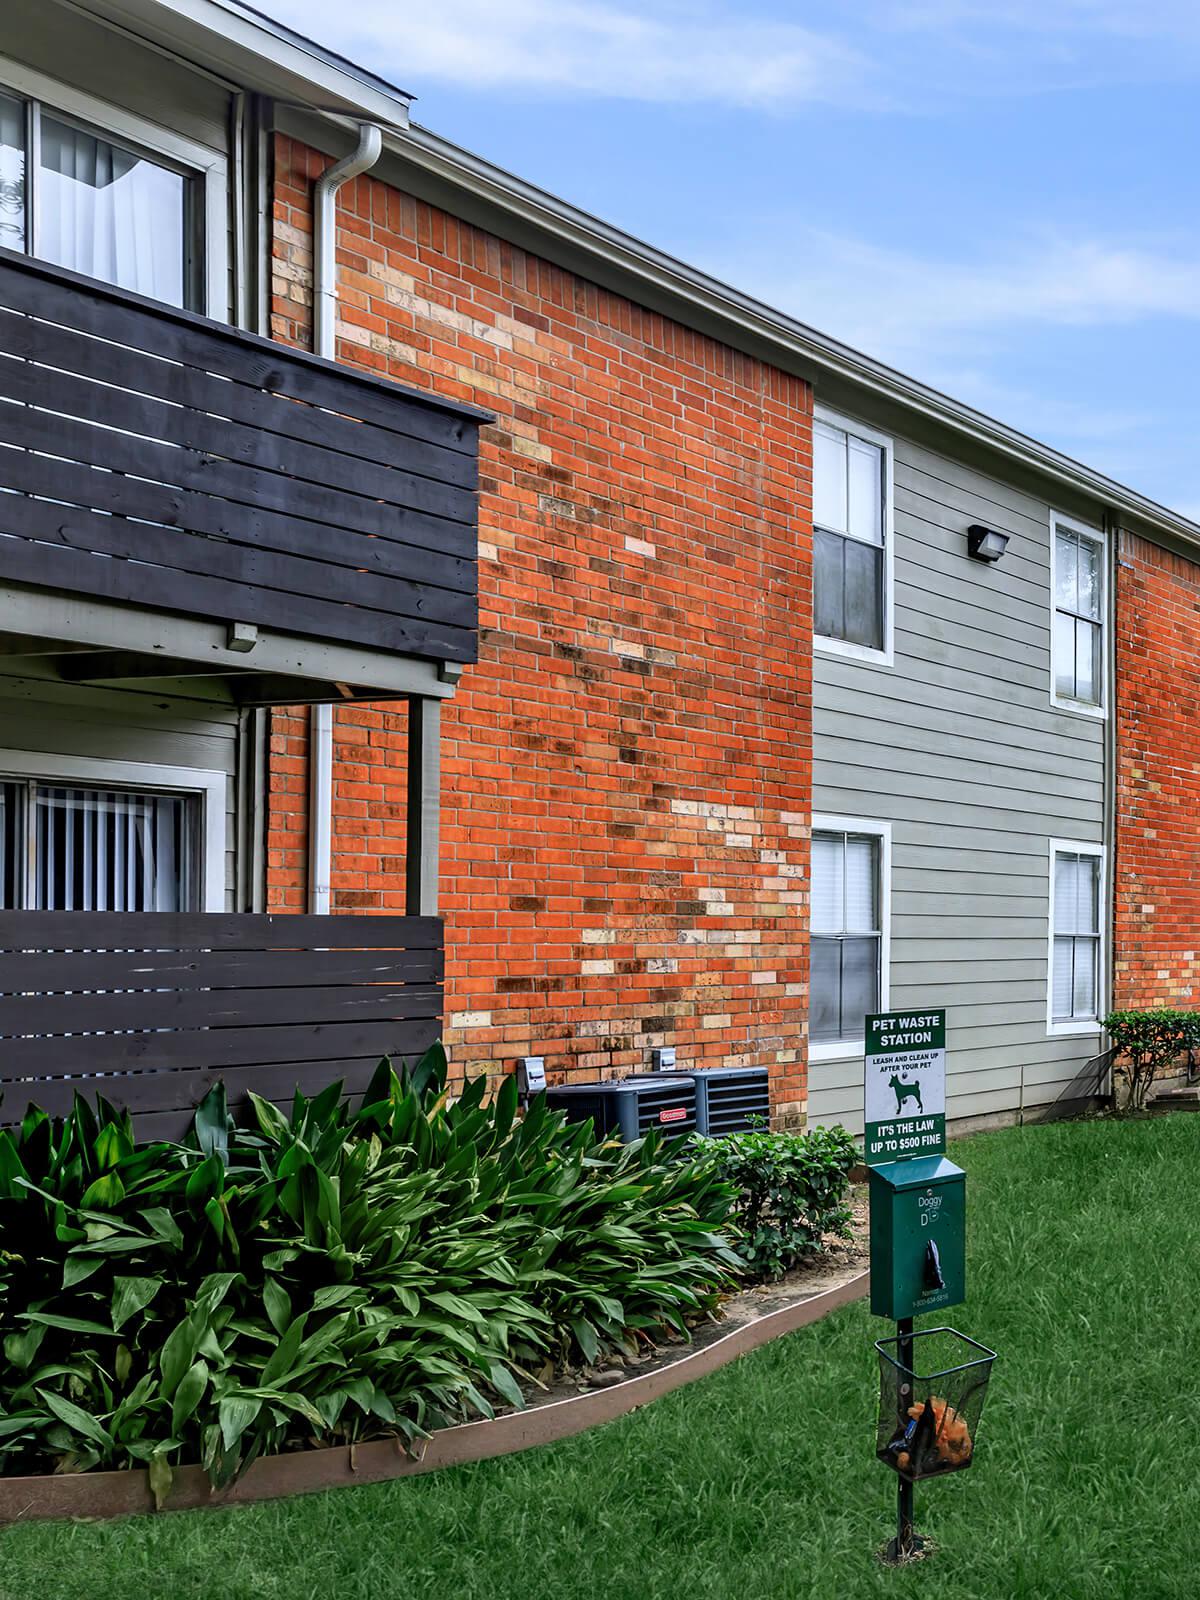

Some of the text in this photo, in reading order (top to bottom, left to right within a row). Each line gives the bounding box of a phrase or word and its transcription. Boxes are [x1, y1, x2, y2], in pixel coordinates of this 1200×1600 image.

[872, 1015, 940, 1031] PET WASTE
[880, 1031, 932, 1046] STATION
[872, 1056, 894, 1065] LEASH
[894, 1055, 907, 1063] AND
[879, 1061, 932, 1073] AFTER YOUR PET
[877, 1120, 935, 1137] IT'S THE LAW
[870, 1134, 941, 1153] UP TO $500 FINE
[918, 1196, 943, 1208] Doggy
